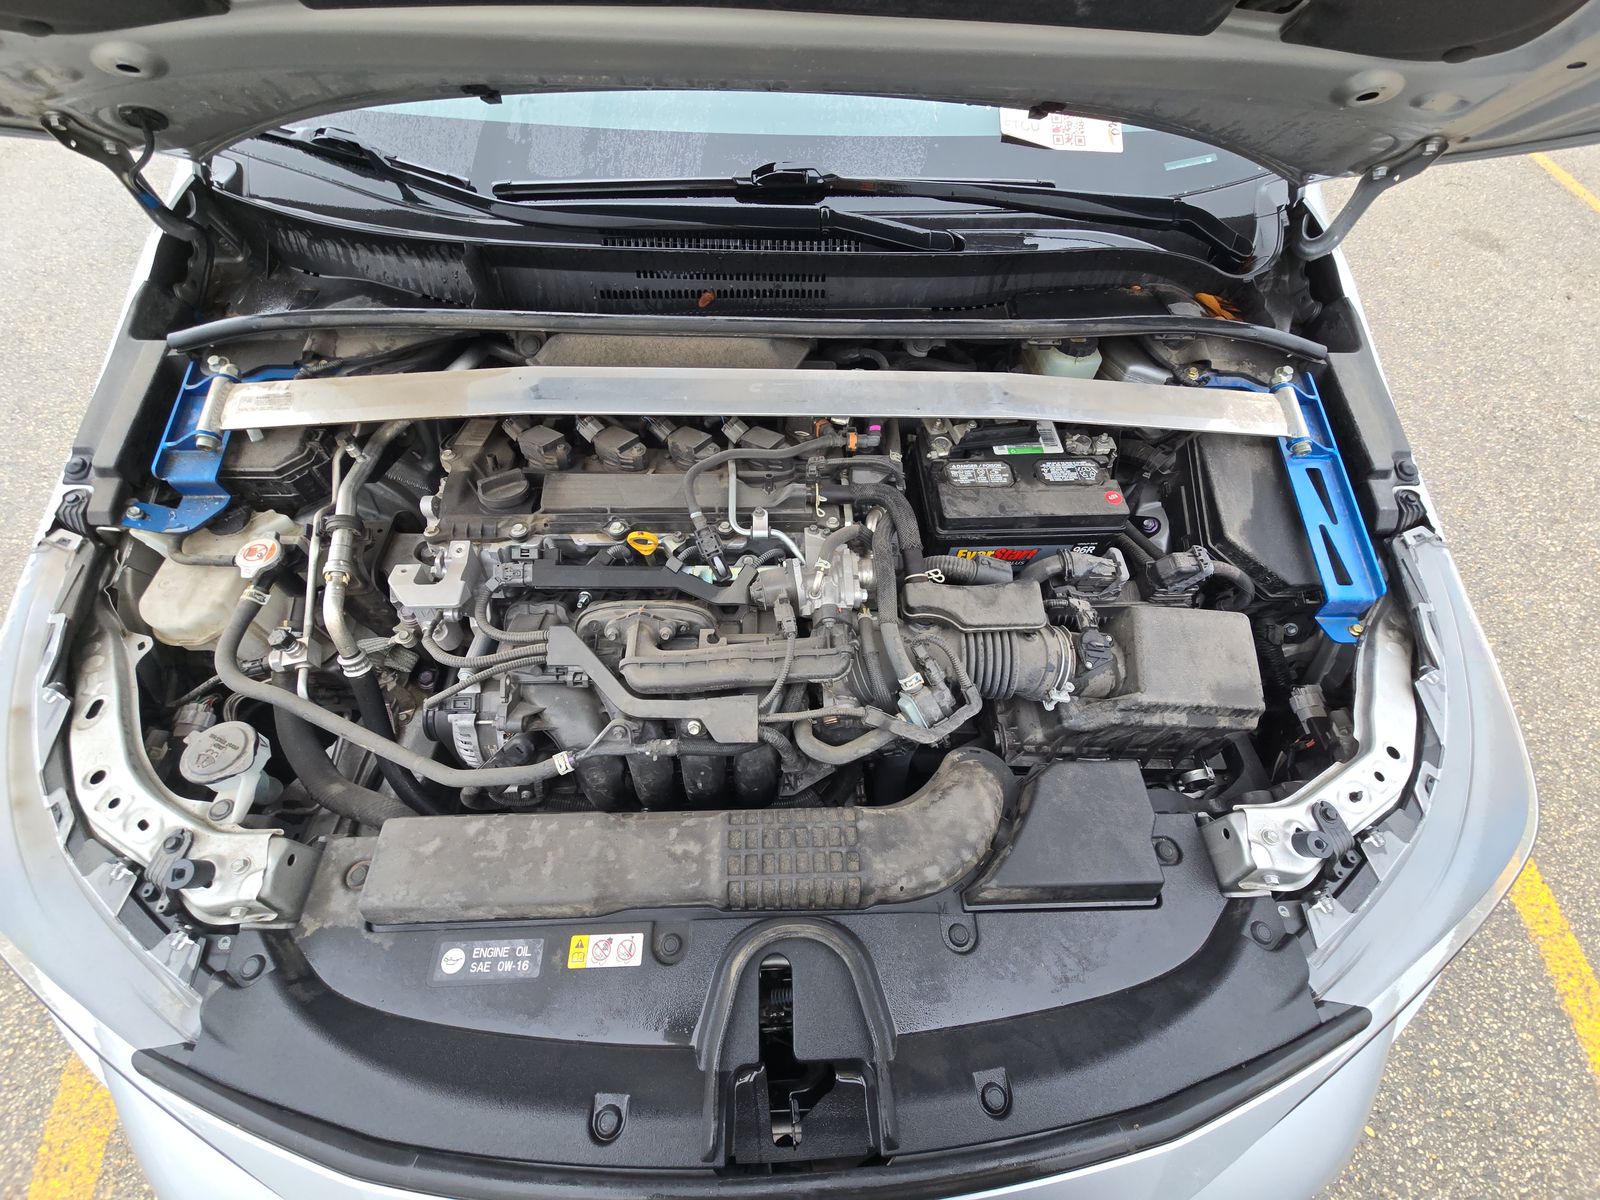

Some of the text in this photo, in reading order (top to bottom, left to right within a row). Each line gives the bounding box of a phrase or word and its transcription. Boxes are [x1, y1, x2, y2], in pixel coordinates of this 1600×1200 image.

[1073, 546, 1096, 554] 96R
[472, 946, 531, 958] ENGINE OIL
[470, 960, 530, 972] SAE 0W-16
